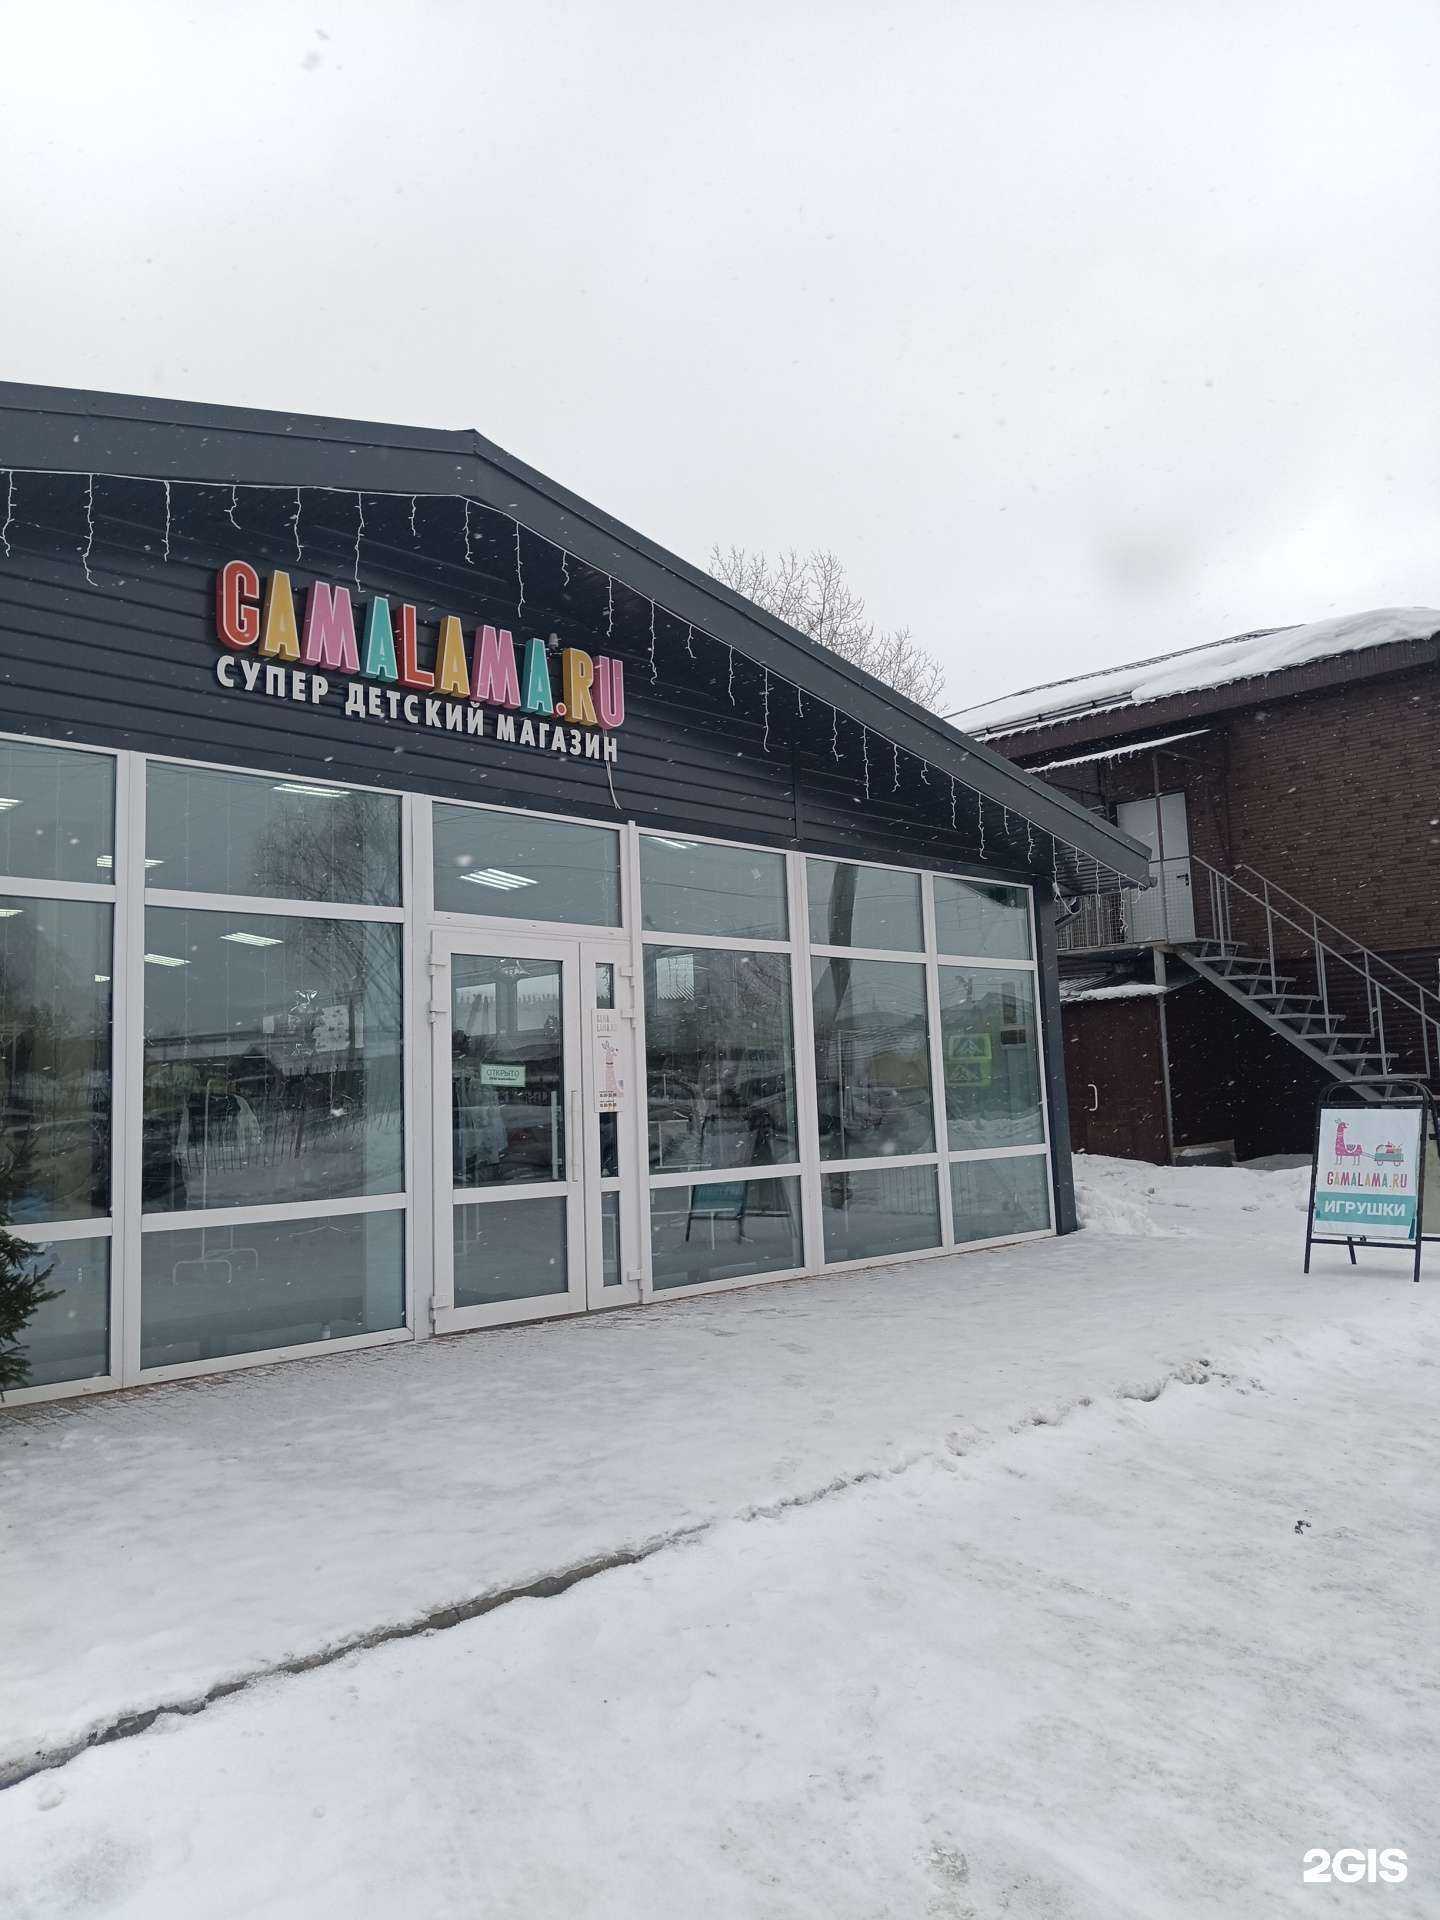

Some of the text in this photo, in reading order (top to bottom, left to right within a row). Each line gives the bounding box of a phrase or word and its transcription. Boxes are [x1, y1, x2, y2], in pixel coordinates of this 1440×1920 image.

[217, 560, 625, 730] GAMALAMA.RU
[216, 655, 618, 763] СУПЕР ДЕТСКИЙ МАГАЗИН
[1324, 1199, 1406, 1218] ИГРУШКИ
[1327, 1171, 1408, 1189] GAMALAMA.RU
